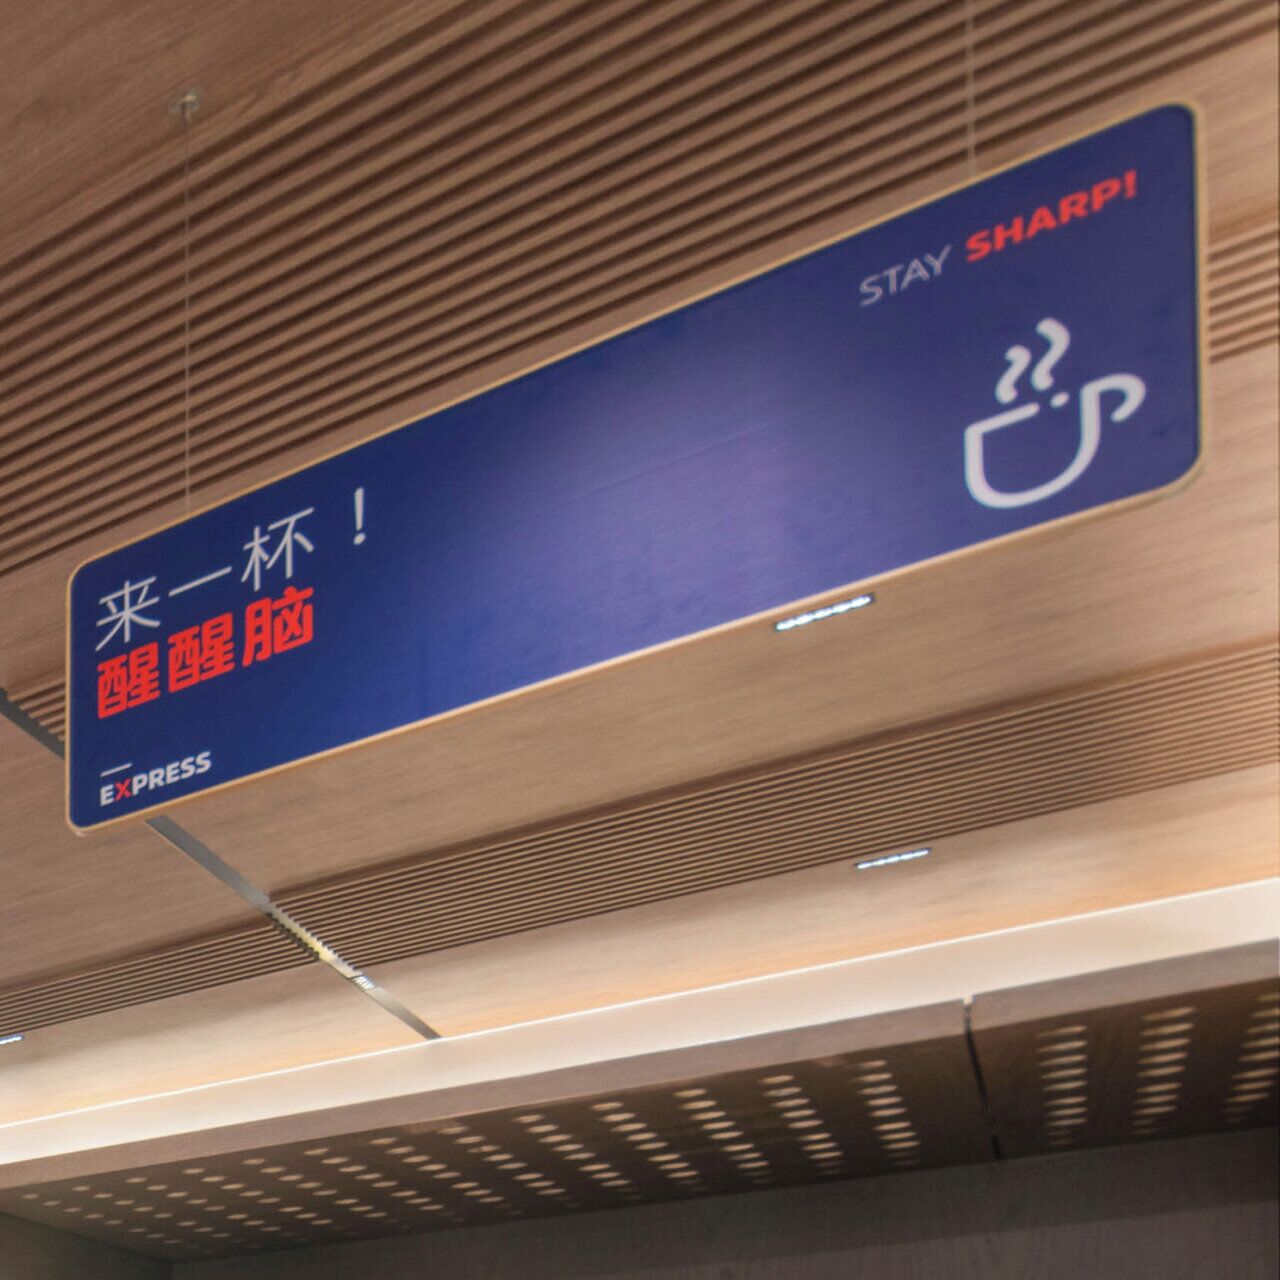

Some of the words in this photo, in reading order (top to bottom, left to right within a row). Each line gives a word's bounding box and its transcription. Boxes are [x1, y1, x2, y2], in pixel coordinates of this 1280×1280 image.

[859, 244, 951, 306] STAY
[965, 169, 1137, 263] SHARP!
[97, 586, 314, 720] 醒醒脑
[100, 751, 212, 807] EXPRESS
